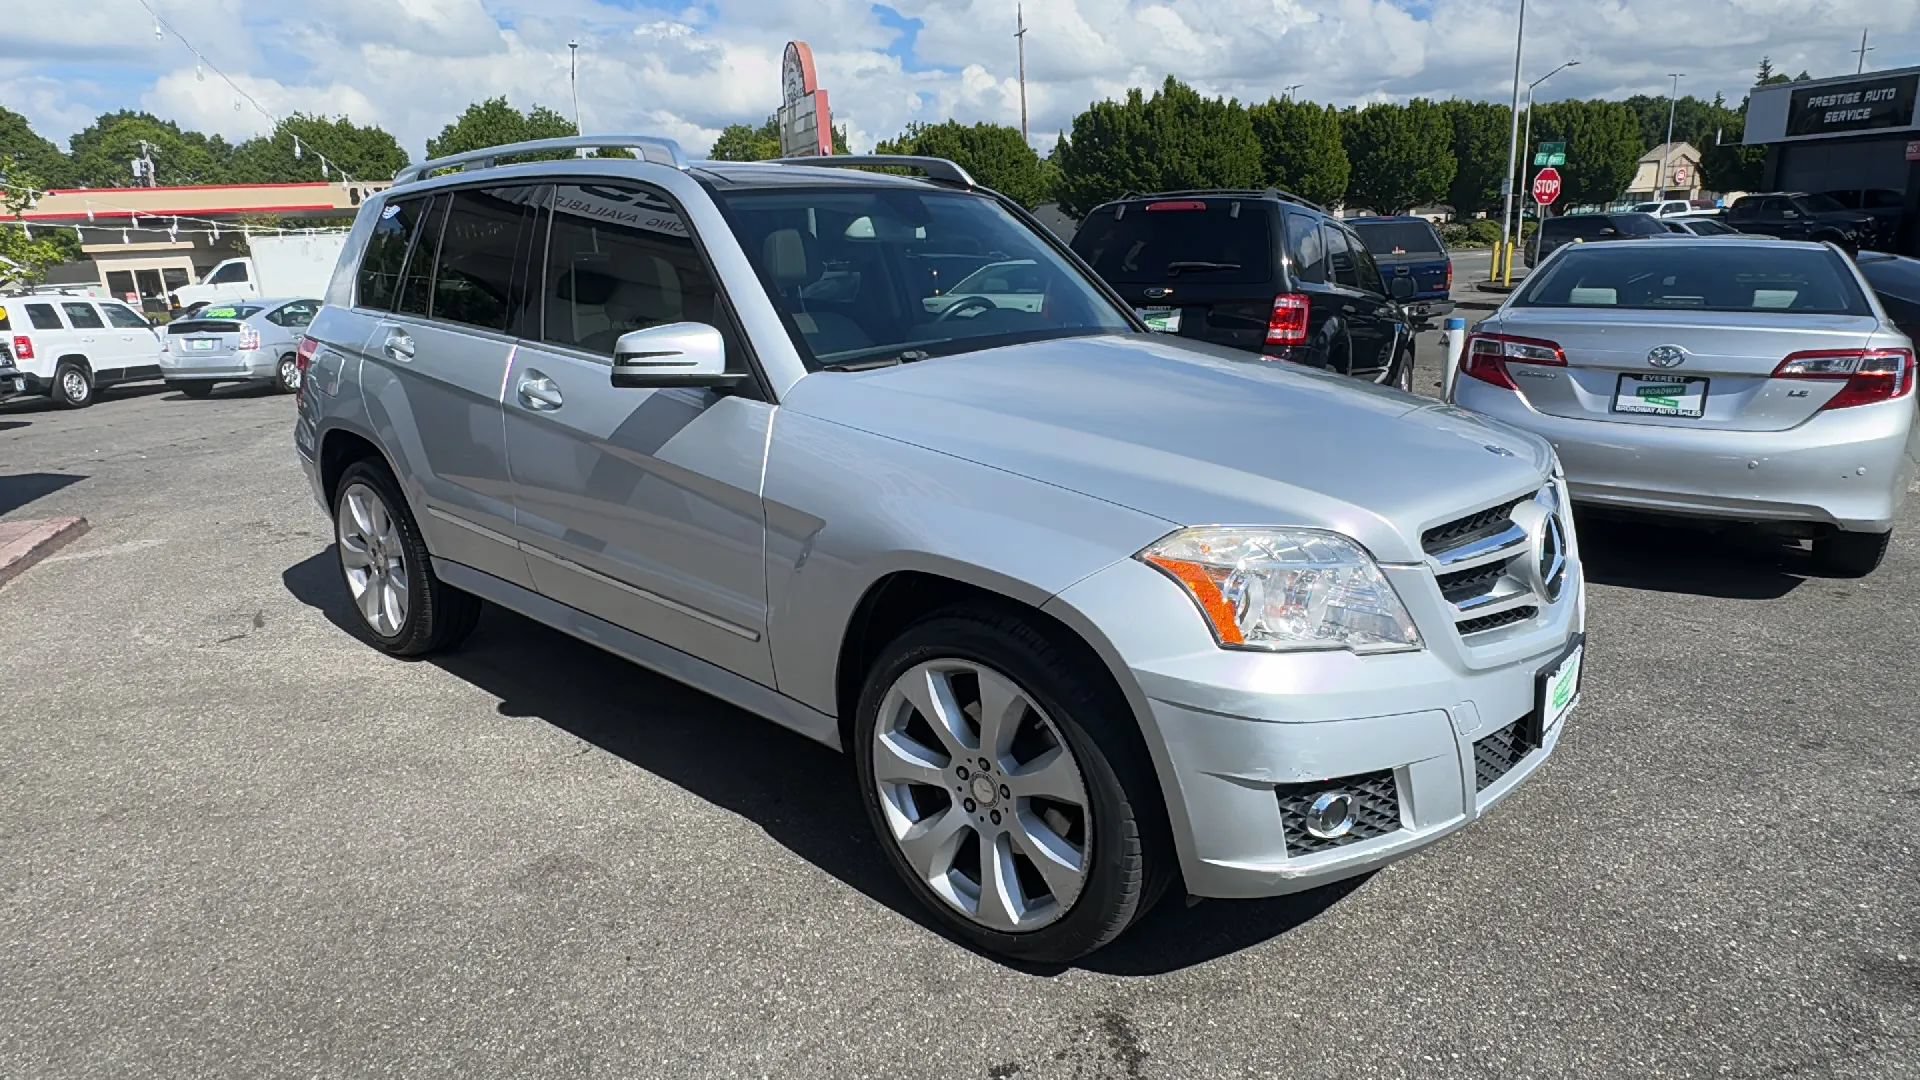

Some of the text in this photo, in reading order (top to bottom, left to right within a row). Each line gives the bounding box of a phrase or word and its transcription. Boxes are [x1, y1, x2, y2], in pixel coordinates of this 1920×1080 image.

[1807, 87, 1896, 108] PRESTIGE AUTO
[1824, 108, 1872, 123] SERVICE
[1535, 180, 1559, 193] STOP
[1642, 374, 1684, 383] EVERETT
[1639, 387, 1682, 395] BROADWAY
[1787, 390, 1809, 398] LE
[1615, 405, 1655, 413] BROADWAY
[1656, 407, 1676, 415] AUTO
